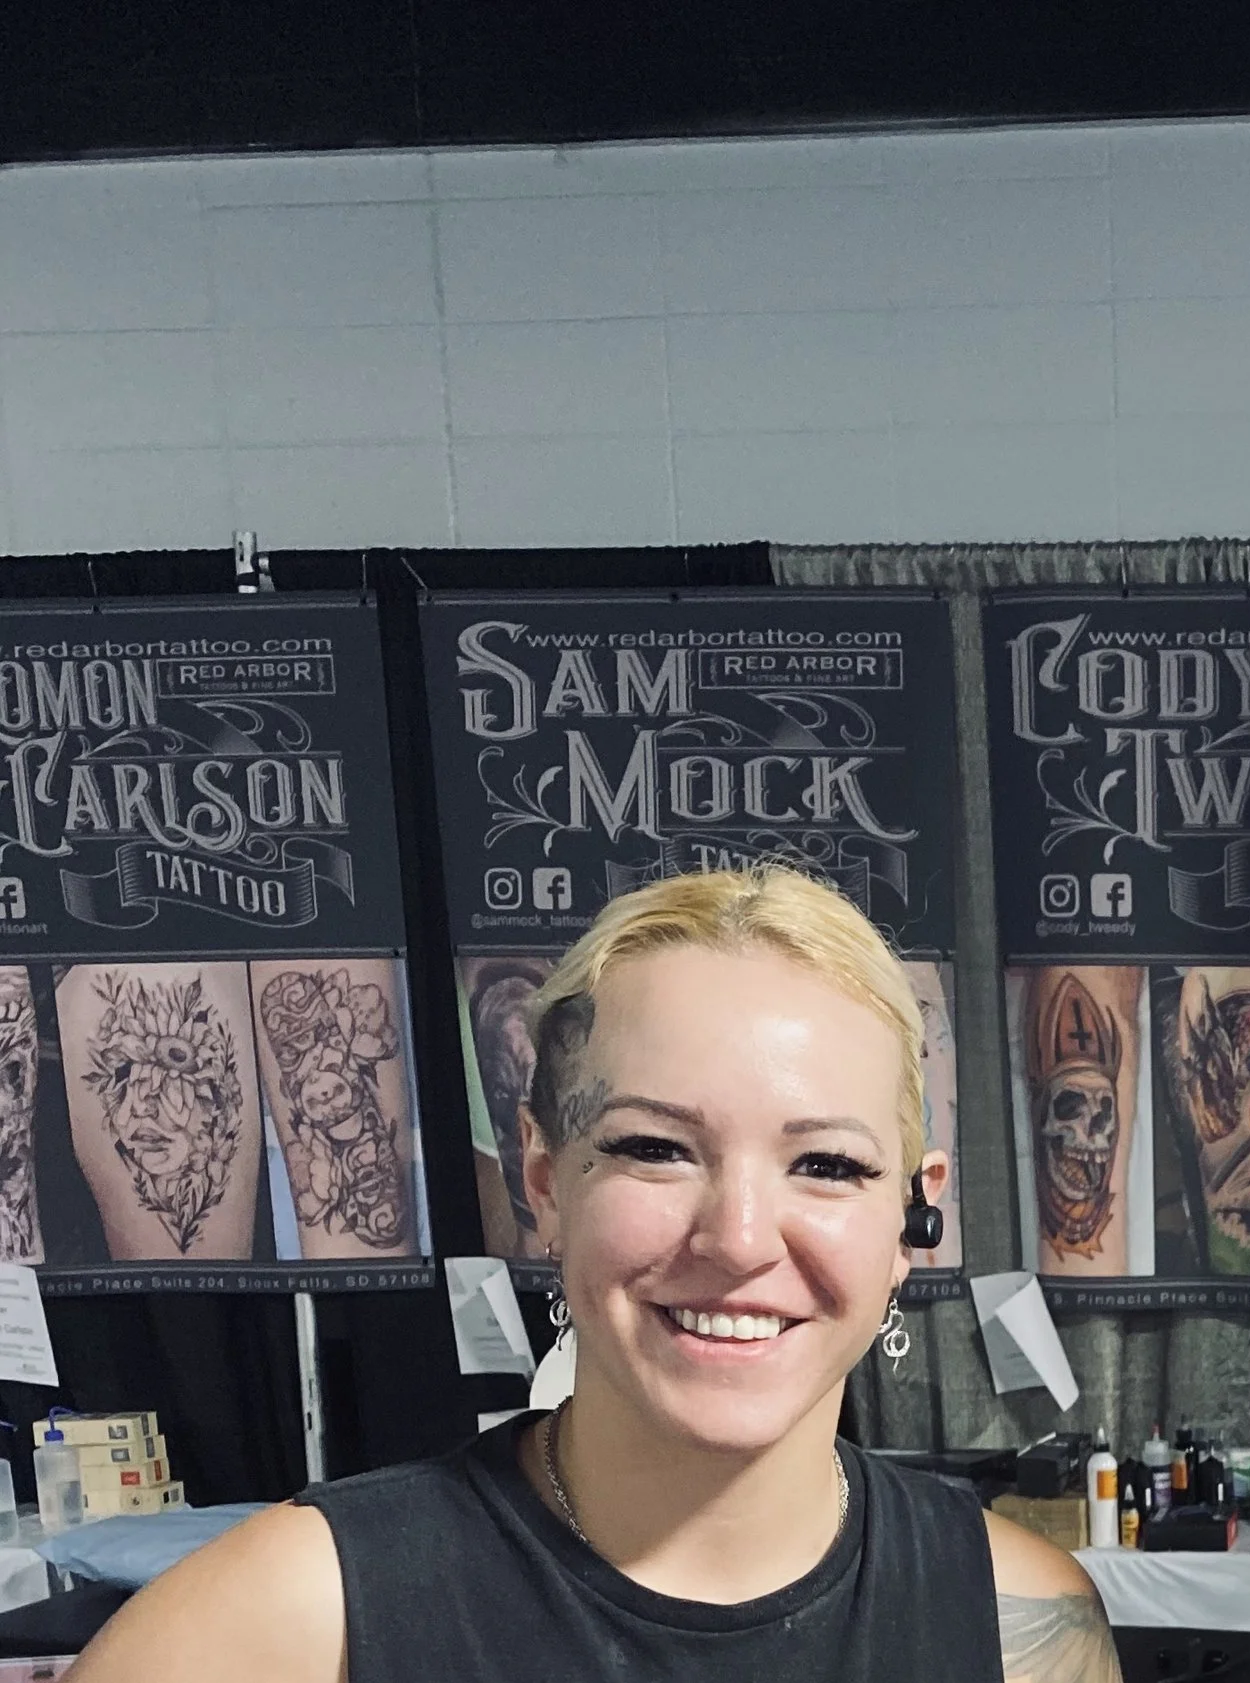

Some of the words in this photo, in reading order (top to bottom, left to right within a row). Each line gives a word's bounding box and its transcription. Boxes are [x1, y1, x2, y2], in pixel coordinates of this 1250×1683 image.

[0, 638, 333, 659] .redarbortattoo.com
[527, 627, 902, 649] www.redarbortattoo.com
[179, 663, 226, 685] RED
[234, 661, 312, 682] ARBOR
[724, 655, 776, 677] RED
[786, 655, 877, 677] ARBOR
[457, 620, 698, 742] SAM
[3, 730, 350, 856] CARLSON
[566, 724, 920, 845] MOCK
[146, 850, 286, 917] TATTOO
[92, 1278, 143, 1291] Place
[345, 1274, 369, 1288] SD
[378, 1273, 430, 1287] 57108
